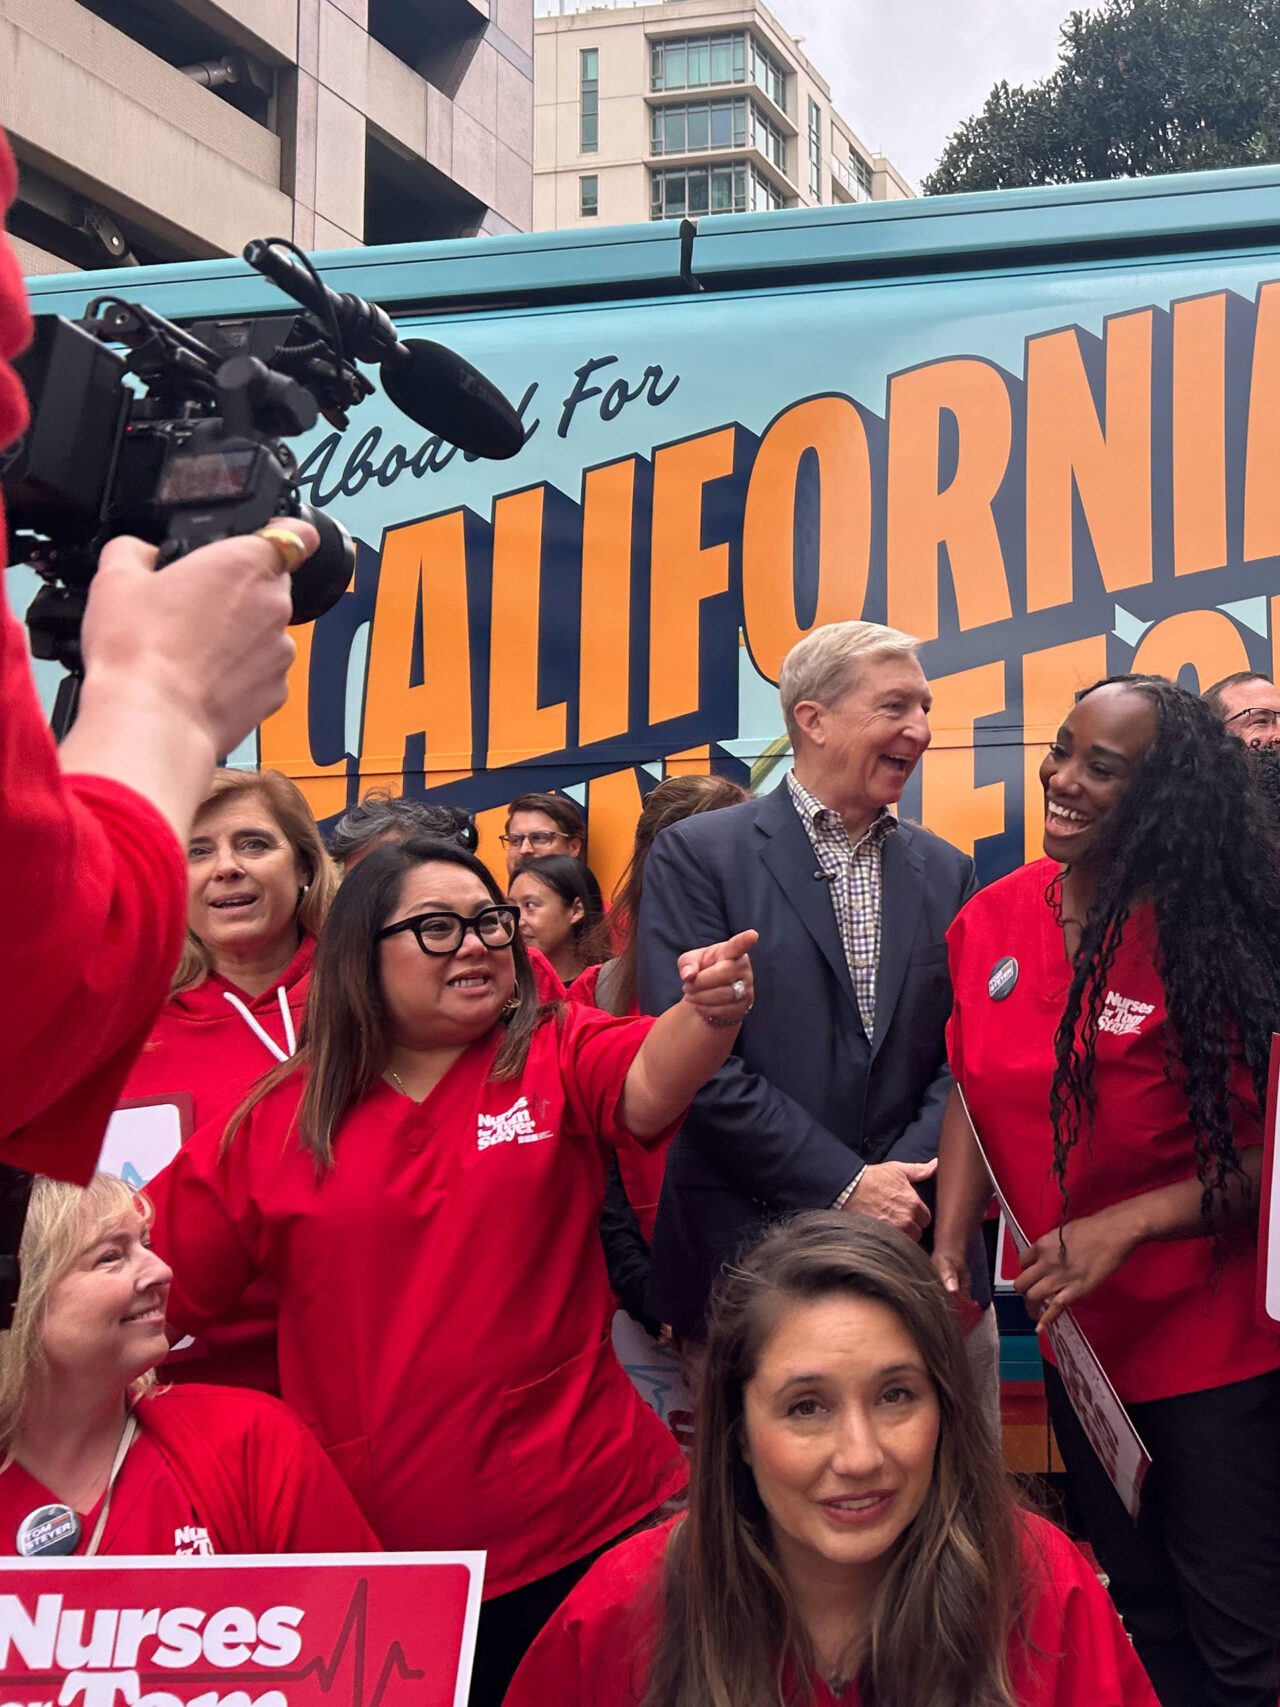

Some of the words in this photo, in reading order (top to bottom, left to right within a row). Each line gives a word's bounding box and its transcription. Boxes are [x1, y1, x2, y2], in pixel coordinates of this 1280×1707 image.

[557, 355, 680, 438] For
[1105, 991, 1156, 1014] Nurses
[25, 1522, 72, 1549] STEYER
[27, 1523, 52, 1541] TOM
[0, 1594, 305, 1670] Nurses
